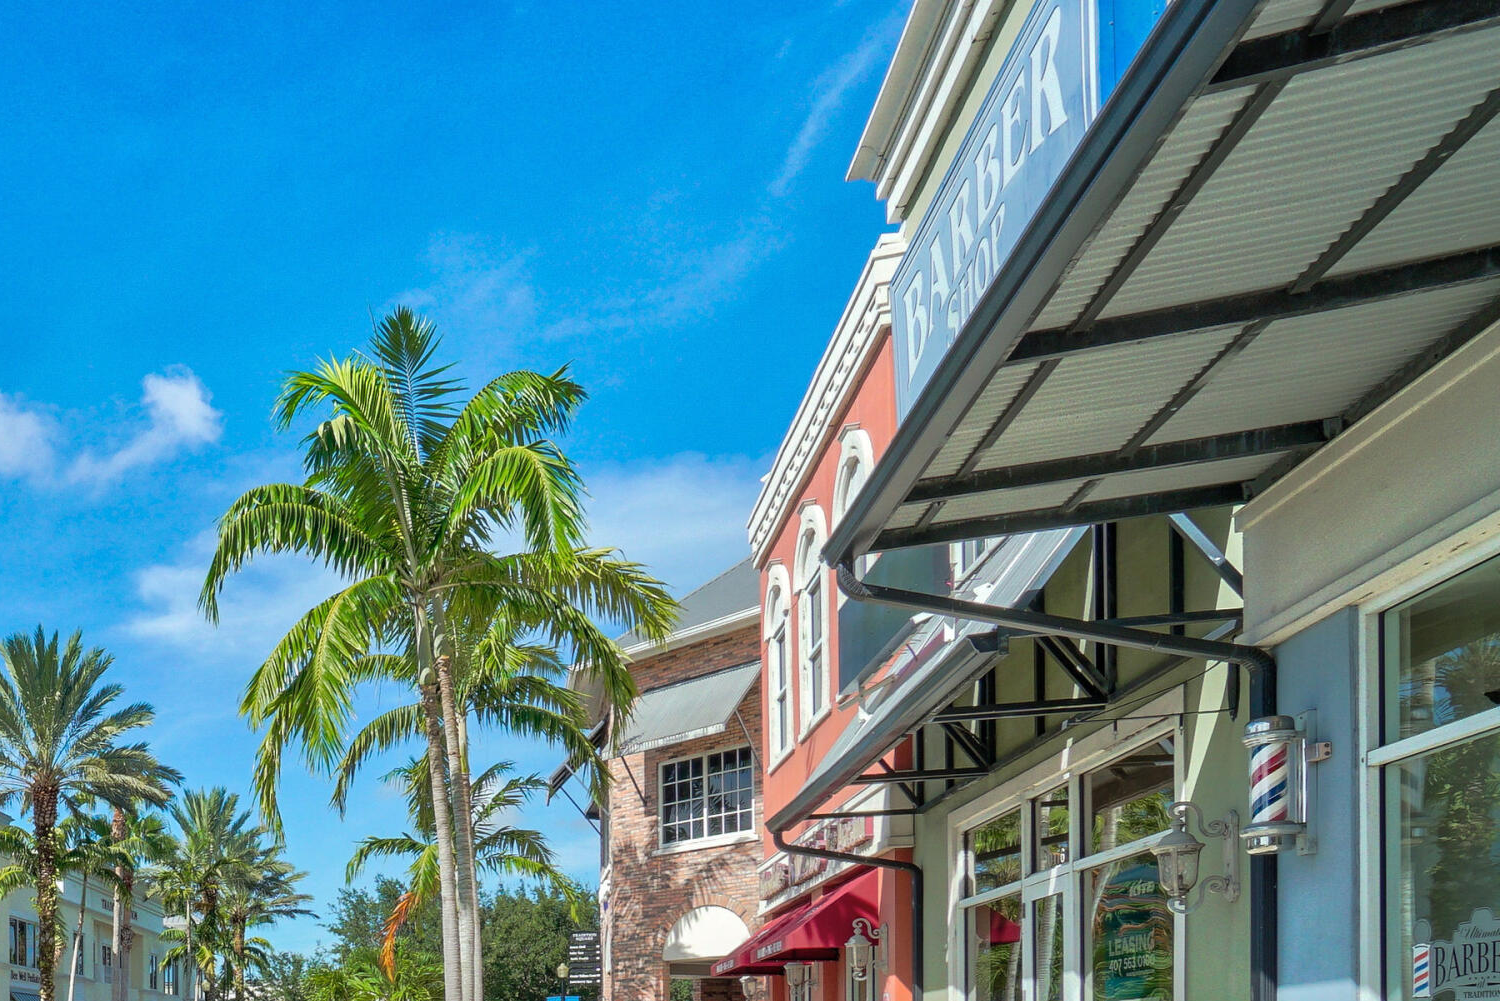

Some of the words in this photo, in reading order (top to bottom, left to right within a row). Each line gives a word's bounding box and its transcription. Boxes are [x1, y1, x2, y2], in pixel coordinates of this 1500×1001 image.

[902, 5, 1068, 391] BARBER
[947, 202, 1005, 350] SHOP
[1109, 931, 1155, 957] LEASING
[1461, 925, 1500, 939] Ultimat
